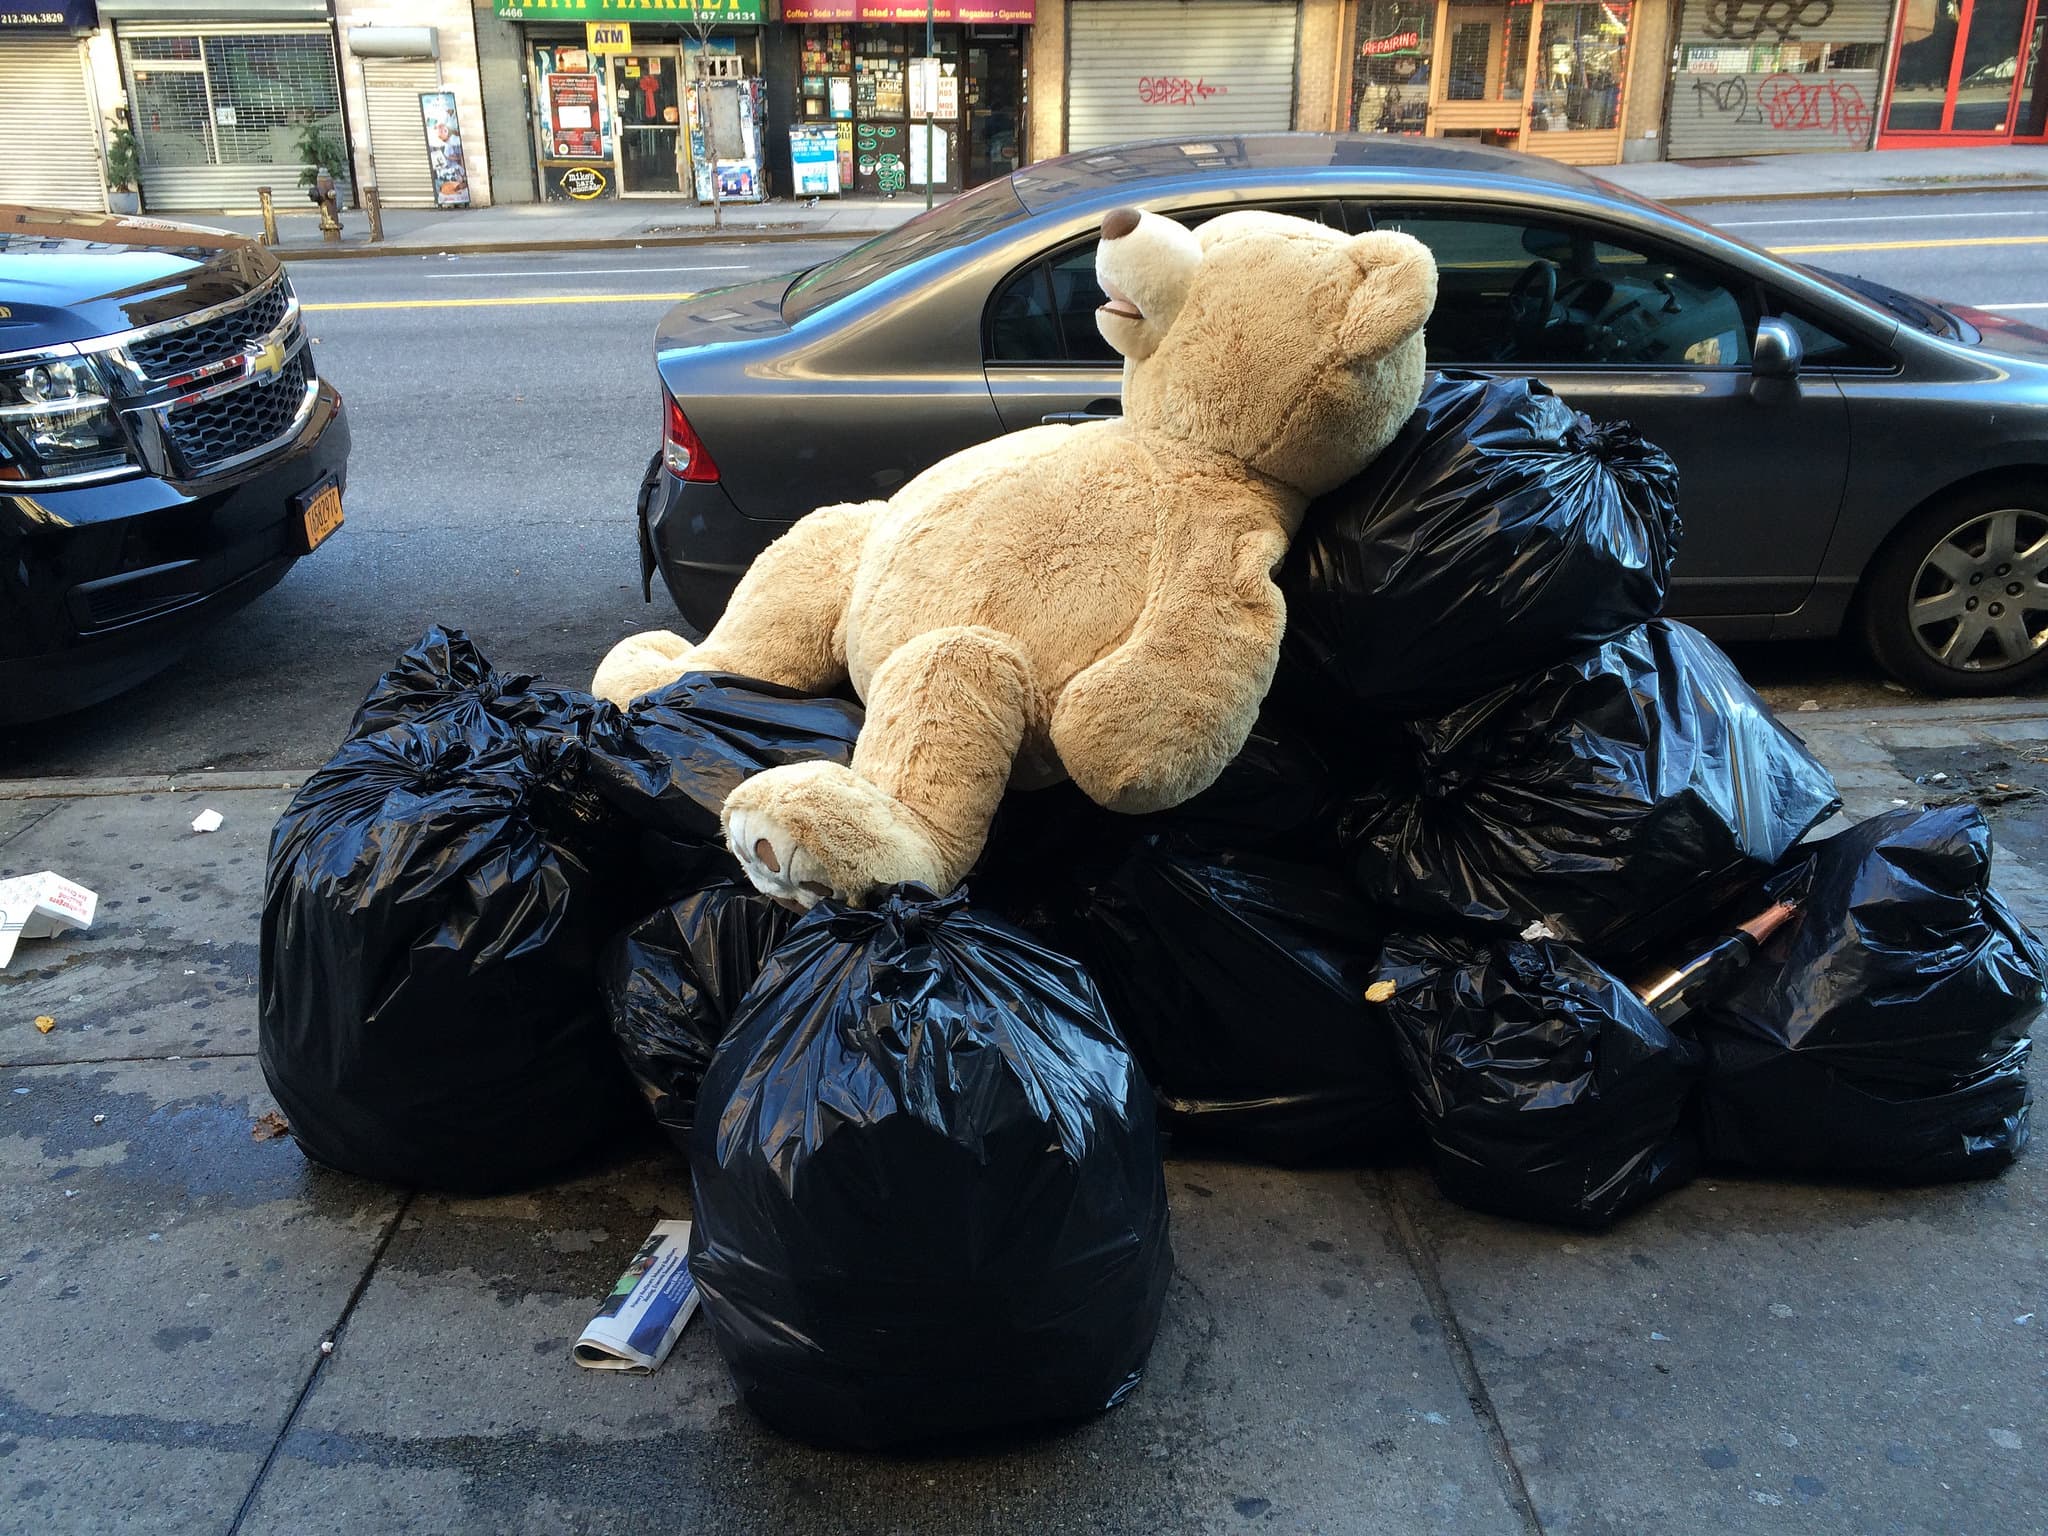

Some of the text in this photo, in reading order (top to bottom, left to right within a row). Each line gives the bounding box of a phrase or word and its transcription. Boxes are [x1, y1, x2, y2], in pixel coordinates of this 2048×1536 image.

[499, 8, 523, 17] 4466
[726, 11, 756, 20] 8131
[862, 8, 889, 17] Salad
[959, 8, 994, 19] Magazines
[998, 10, 1032, 20] Cigarettes
[594, 30, 624, 43] ATM
[1365, 32, 1418, 54] REPAIRING
[876, 81, 903, 92] LOGIC
